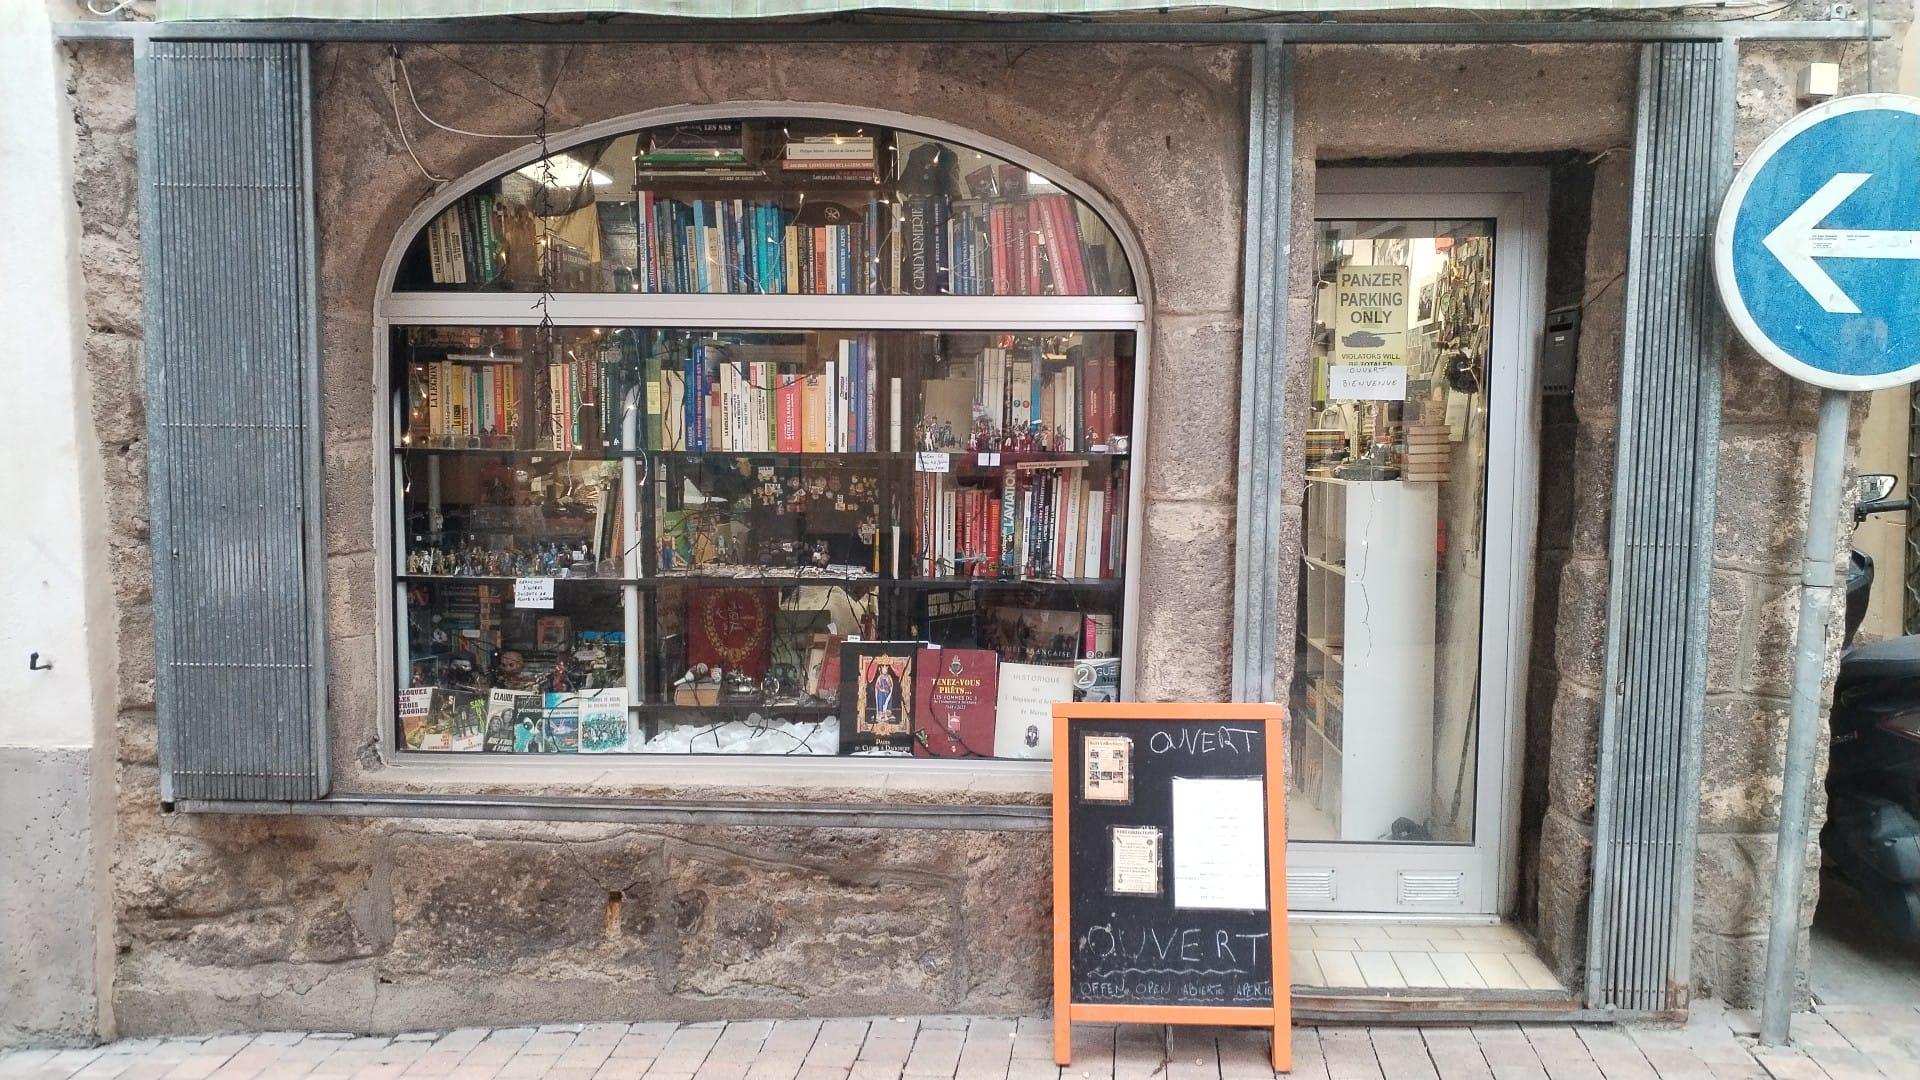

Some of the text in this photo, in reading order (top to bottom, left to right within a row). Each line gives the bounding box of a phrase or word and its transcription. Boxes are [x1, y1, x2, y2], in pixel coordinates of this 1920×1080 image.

[912, 208, 925, 290] GENDARMERIE
[1342, 273, 1402, 287] PANZER
[1340, 292, 1402, 306] PARKING
[1351, 310, 1392, 323] ONLY
[1342, 379, 1398, 387] BIENVENUE
[430, 399, 438, 408] LA
[1003, 469, 1016, 528] L'AVIATION
[931, 678, 981, 687] TENEZ-VOUS
[1077, 668, 1092, 684] 2
[939, 686, 972, 694] PRÊTS...
[1150, 726, 1259, 755] OUVERT
[1087, 924, 1269, 966] OUVERT
[1080, 978, 1273, 997] OFFEN OPEN ABIERTO APERTO
